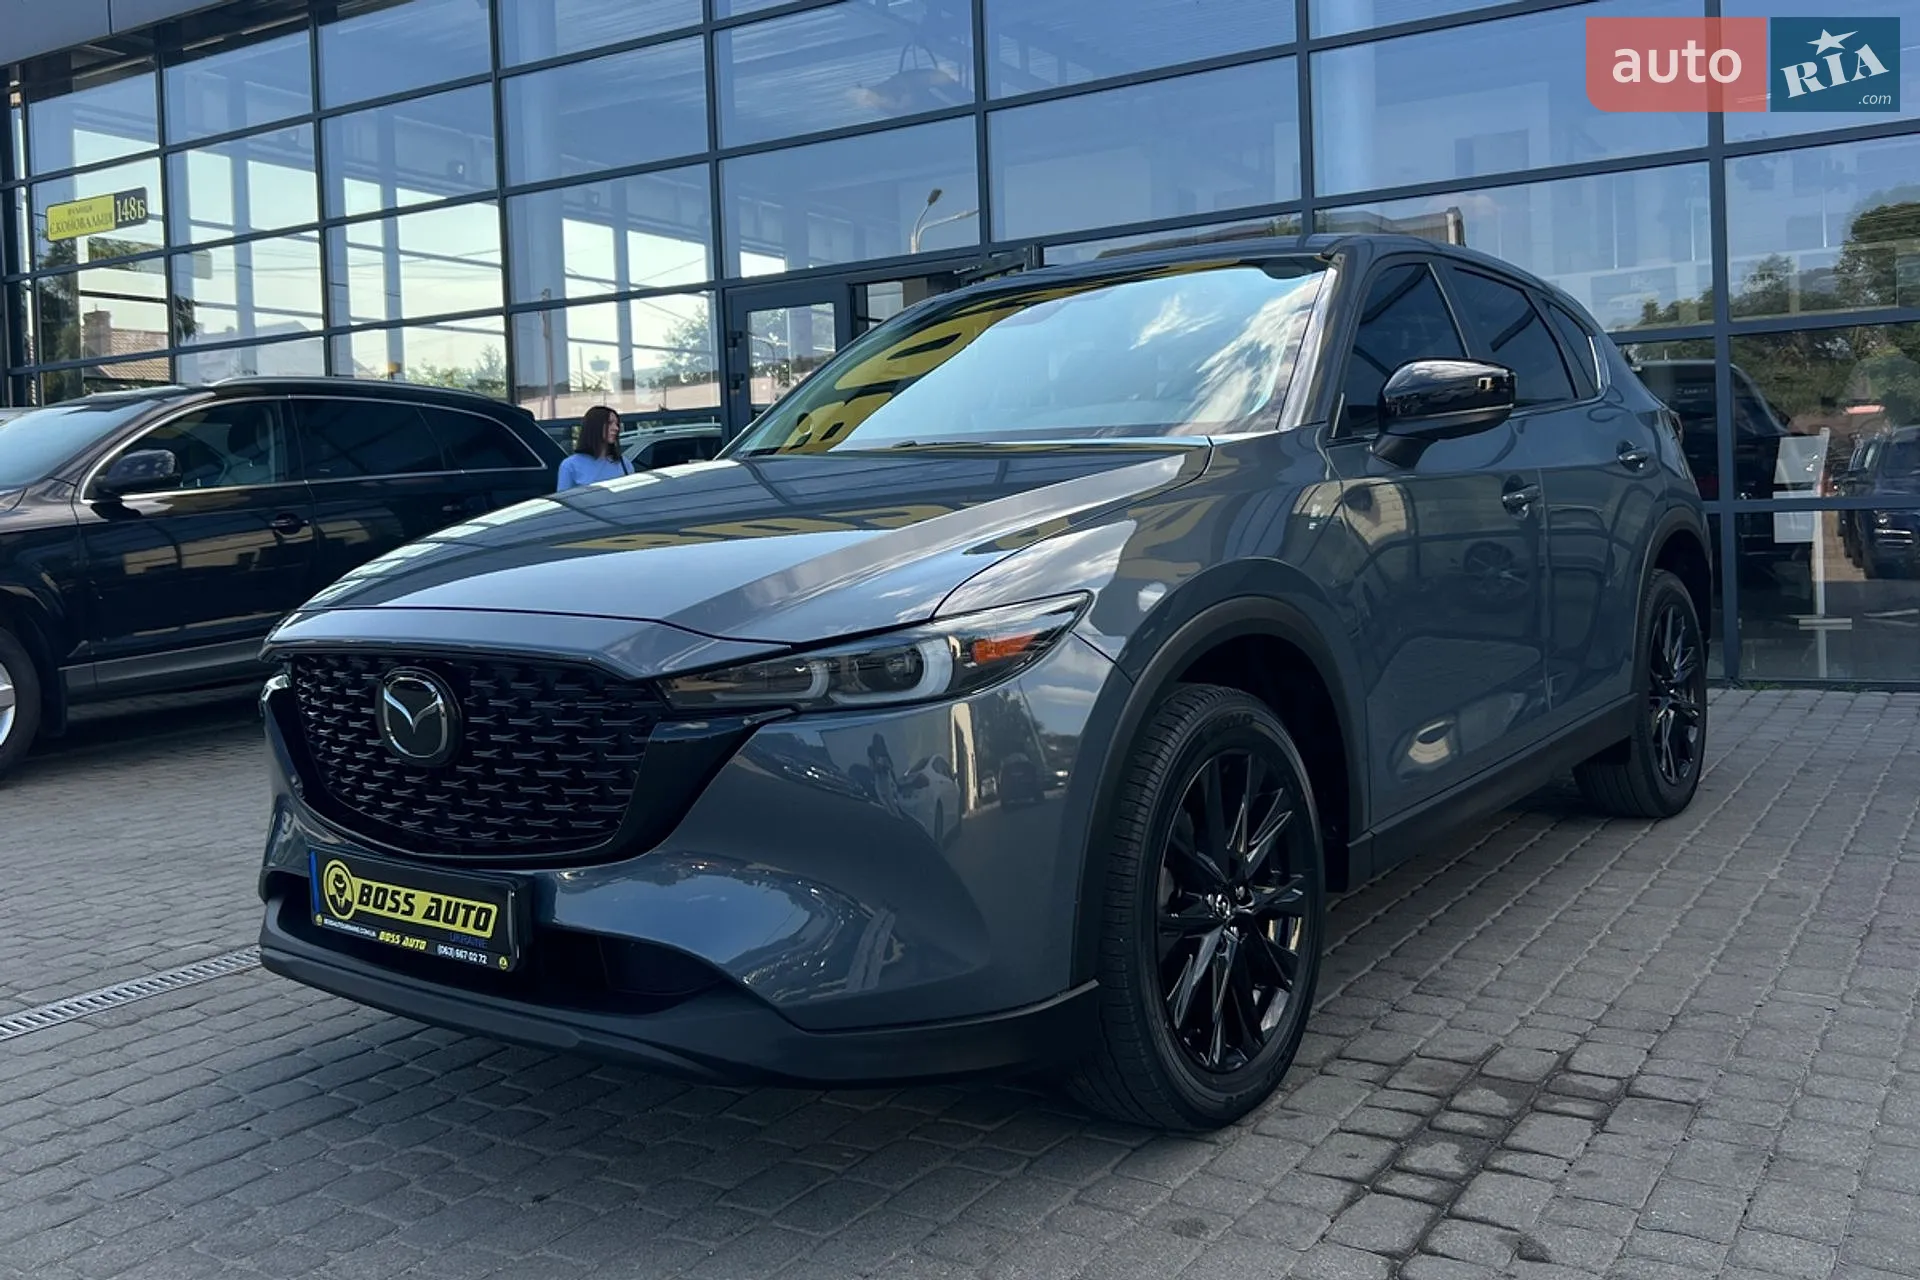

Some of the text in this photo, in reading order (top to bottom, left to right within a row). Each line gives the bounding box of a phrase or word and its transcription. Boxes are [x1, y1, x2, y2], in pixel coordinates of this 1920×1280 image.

[116, 197, 145, 222] 148Б
[357, 883, 493, 932] BOSS AUTO
[379, 931, 427, 950] BOSS AUTO
